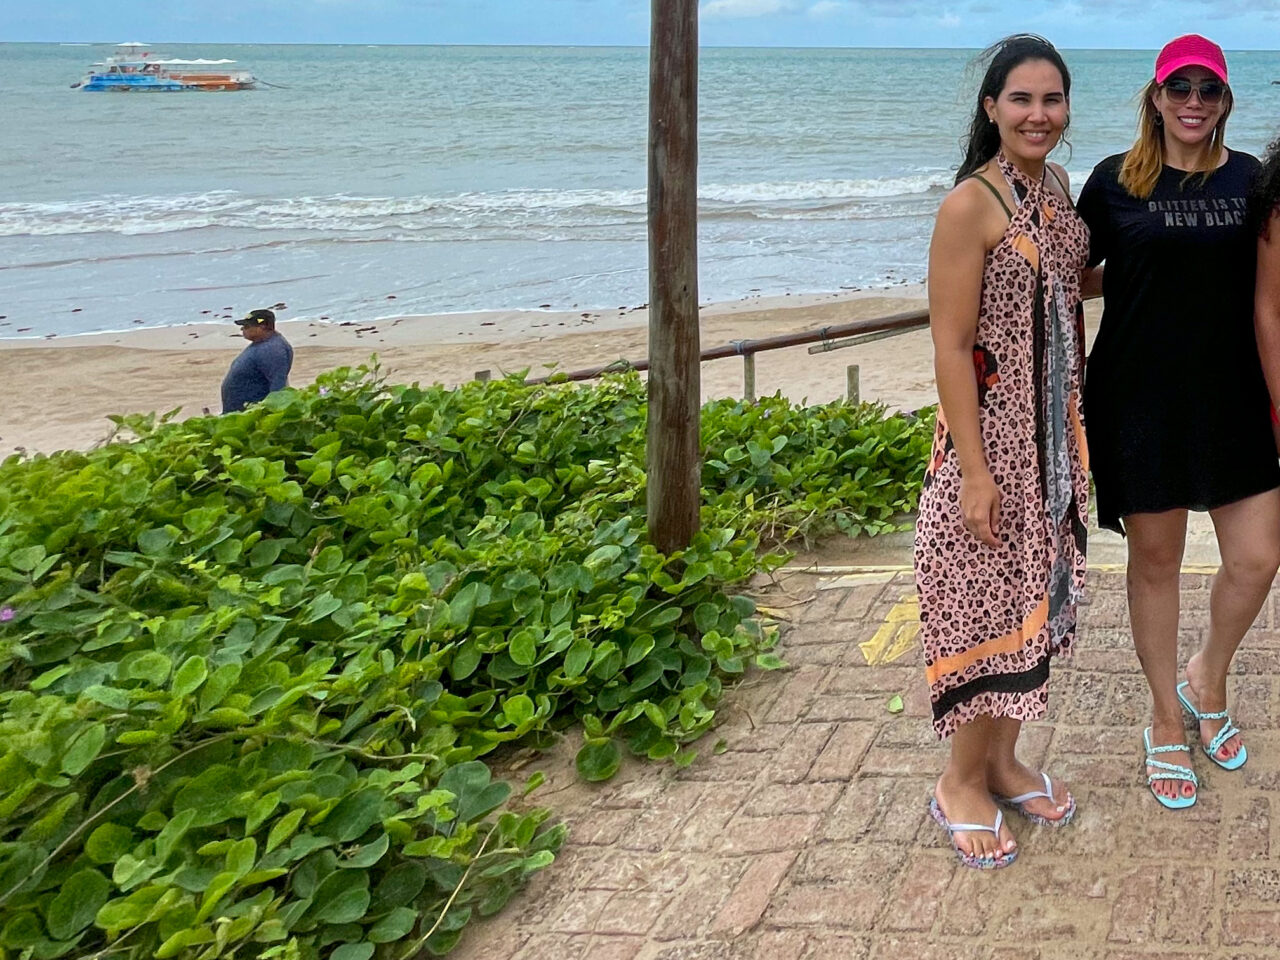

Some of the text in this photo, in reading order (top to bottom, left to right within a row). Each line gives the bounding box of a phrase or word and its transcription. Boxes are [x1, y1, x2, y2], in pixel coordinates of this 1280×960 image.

[1212, 198, 1229, 210] IS
[1164, 210, 1246, 227] NEW BLAC
